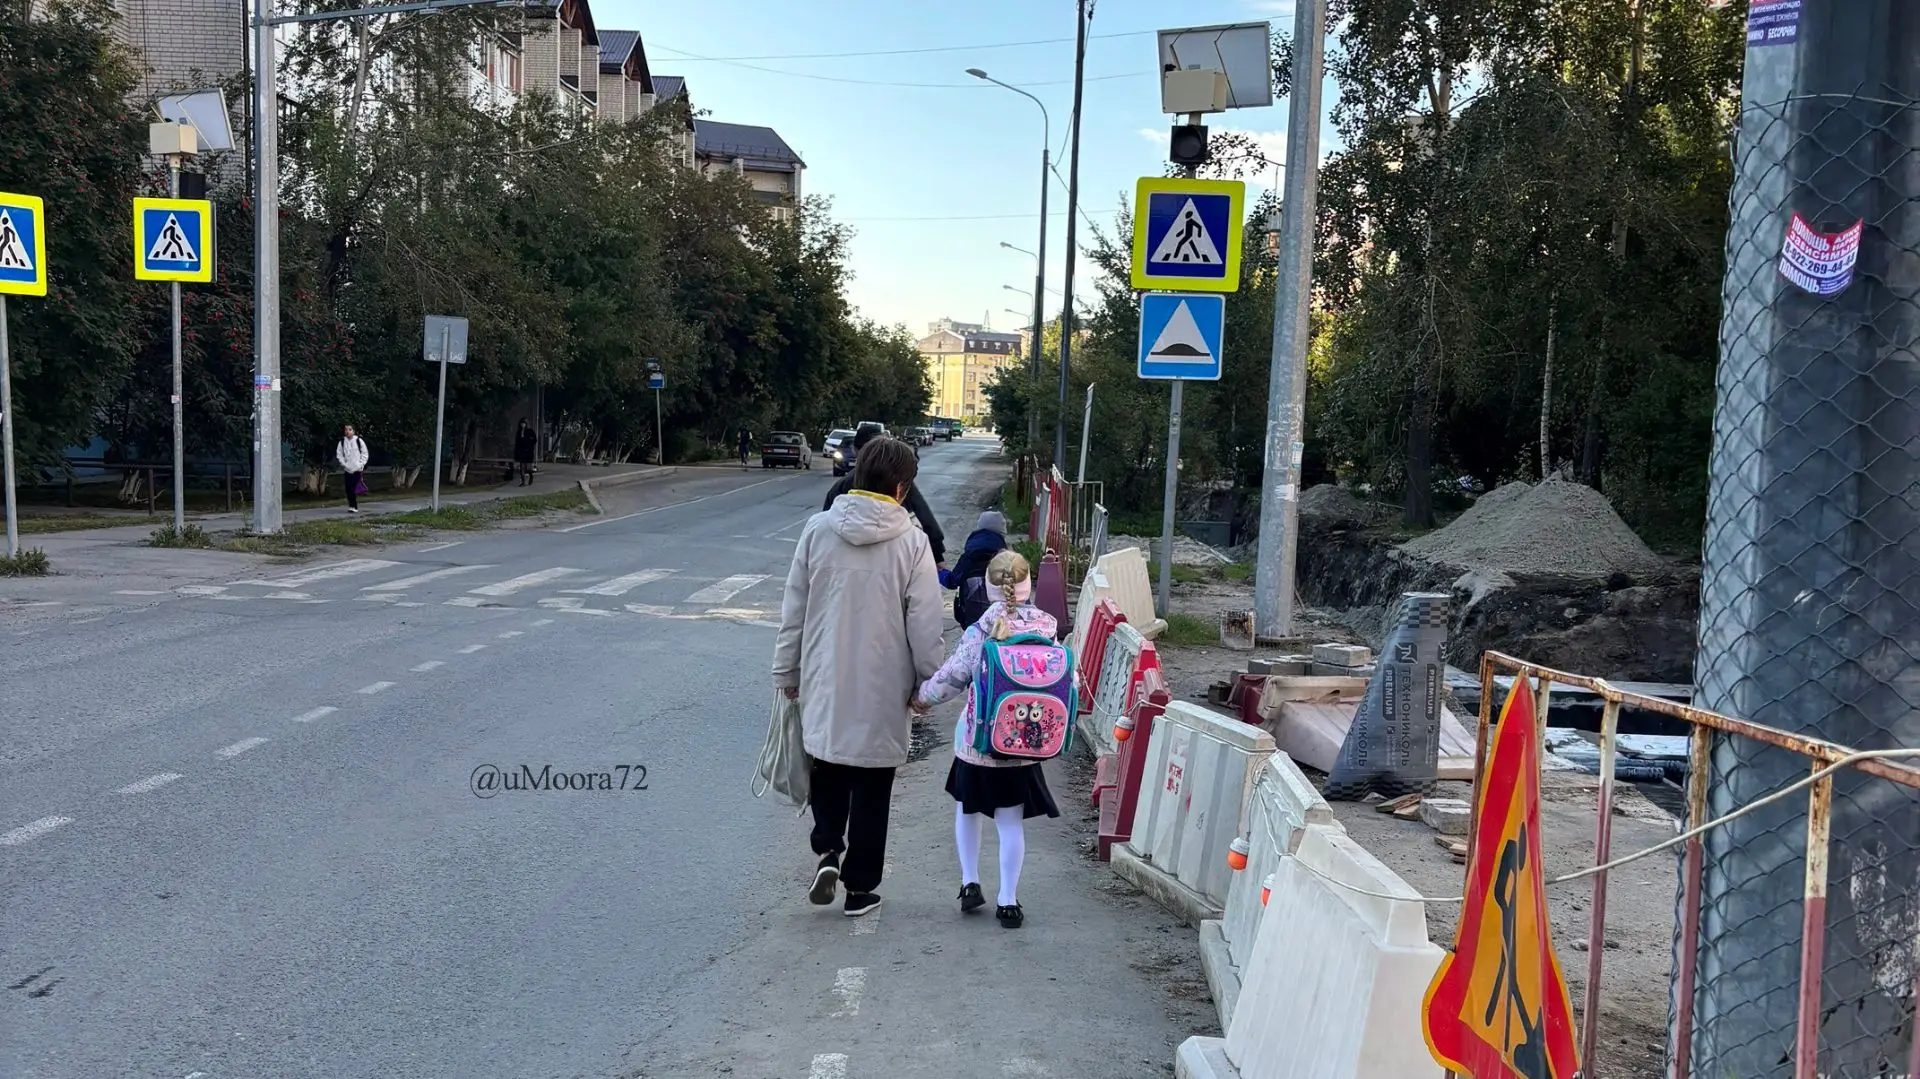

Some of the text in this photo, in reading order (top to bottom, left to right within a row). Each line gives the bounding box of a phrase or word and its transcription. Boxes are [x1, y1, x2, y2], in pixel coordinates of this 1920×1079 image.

[1792, 215, 1830, 251] ПОМОЩЬ
[1779, 257, 1820, 293] ПОМОЩЬ
[1385, 669, 1393, 715] PREMIUM
[1427, 669, 1435, 714] PREMIUM
[1400, 668, 1412, 766] ТЕХНОНИКОЛЬ
